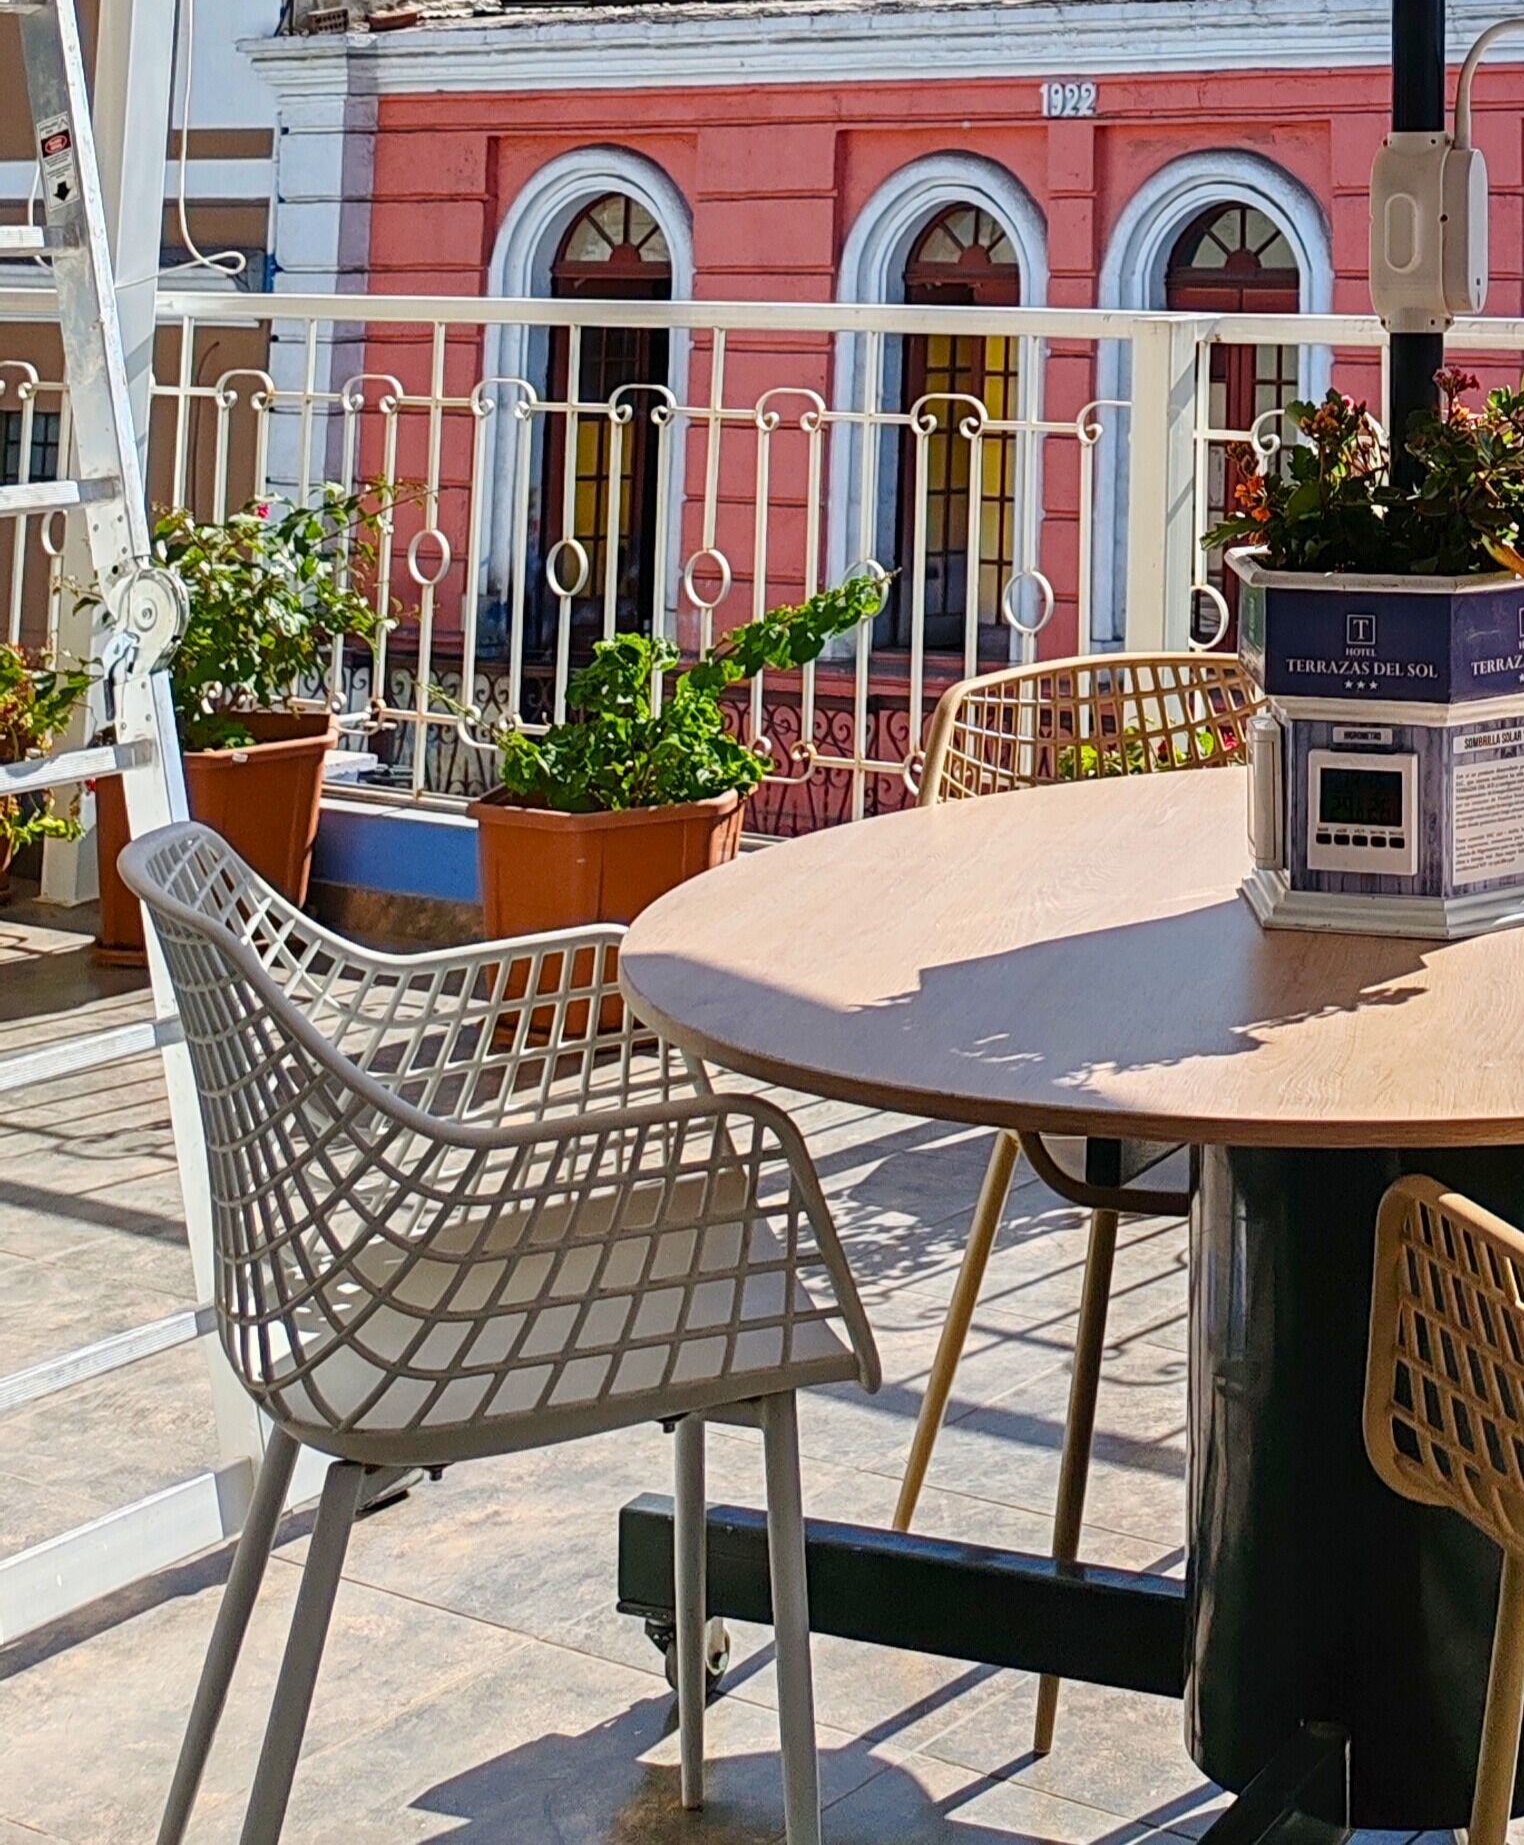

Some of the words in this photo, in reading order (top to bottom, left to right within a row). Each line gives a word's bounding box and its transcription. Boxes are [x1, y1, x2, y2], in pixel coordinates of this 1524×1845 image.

[1039, 82, 1097, 117] 1922
[1352, 619, 1369, 640] T
[1345, 647, 1376, 657] HOTEL
[1286, 658, 1370, 675] TERRAZAS
[1374, 662, 1404, 677] DEL
[1407, 663, 1438, 678] SOL
[1464, 734, 1500, 749] SOMBRILLA
[1502, 730, 1522, 744] SOLAR
